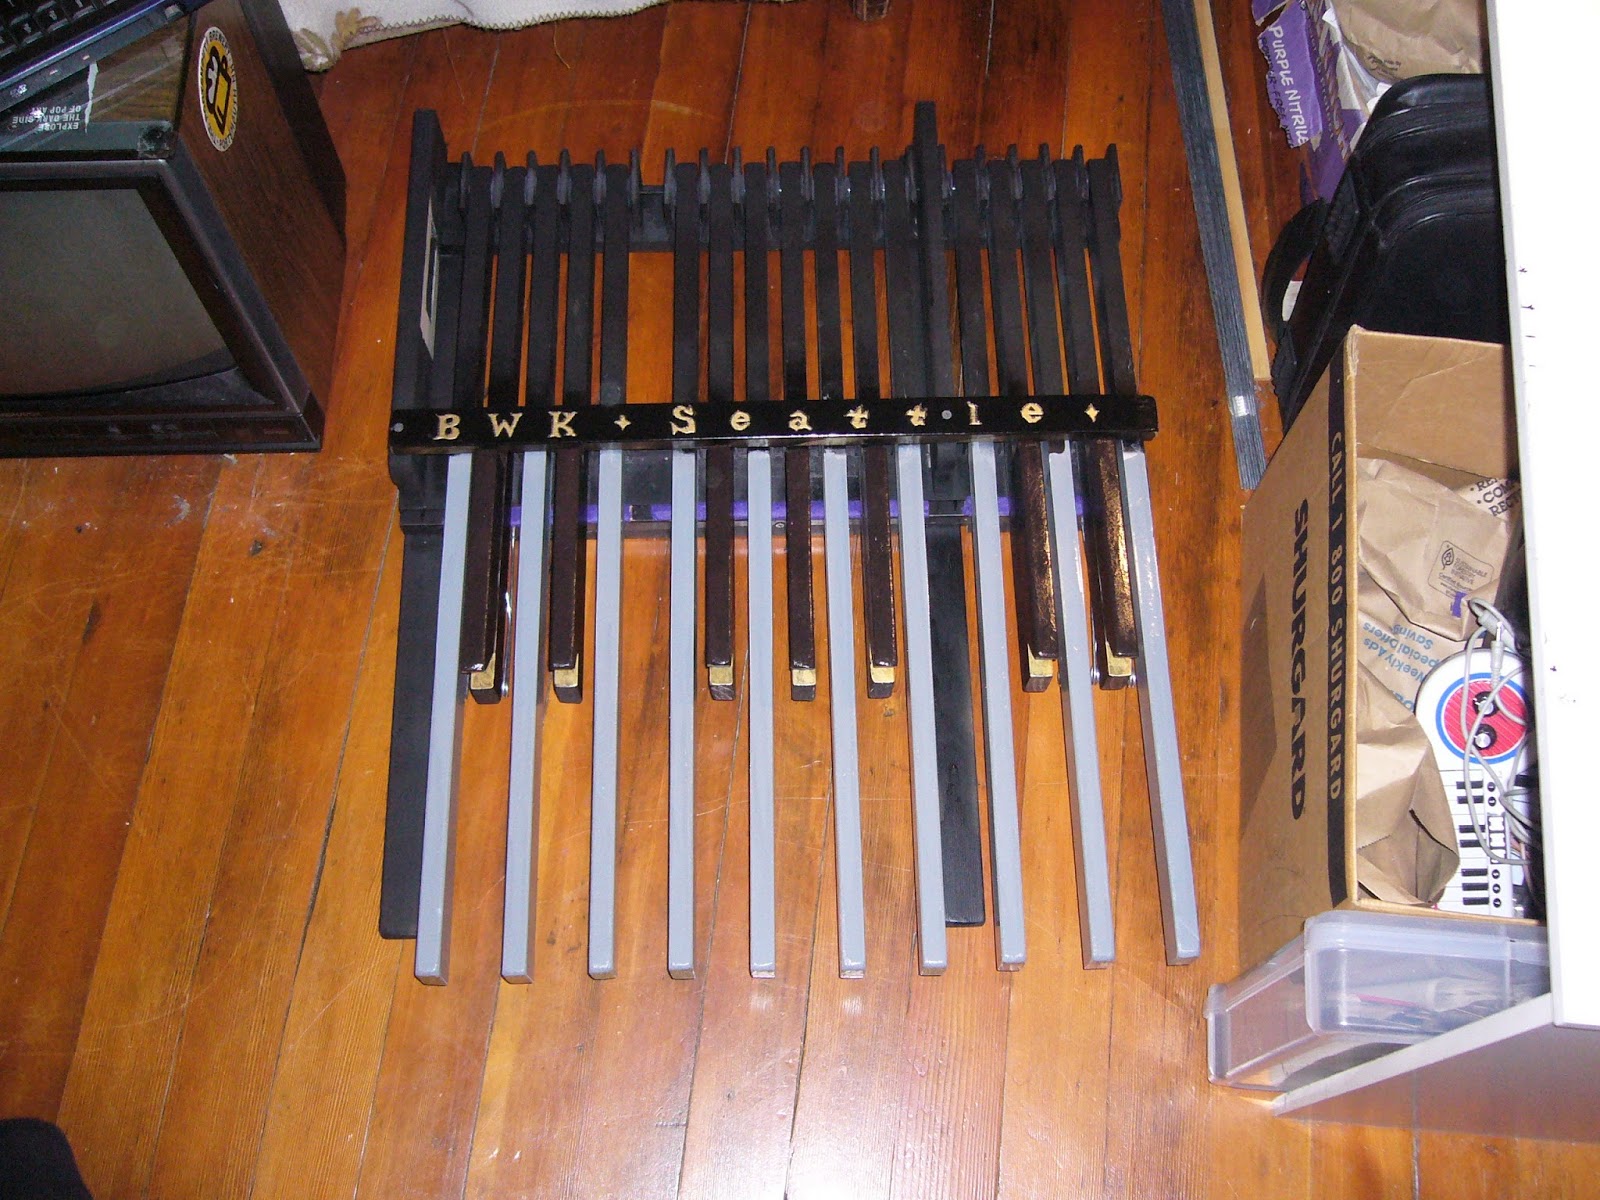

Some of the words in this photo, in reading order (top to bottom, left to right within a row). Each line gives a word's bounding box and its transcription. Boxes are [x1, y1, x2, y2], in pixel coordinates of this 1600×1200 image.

[1268, 25, 1294, 87] PURPLE
[1285, 89, 1309, 146] NITRILE
[49, 106, 67, 114] POP
[62, 113, 80, 122] THE
[69, 105, 81, 113] OF
[38, 122, 79, 131] EXPLORE
[1331, 431, 1343, 505] CALL
[1332, 513, 1343, 532] 1
[1331, 545, 1343, 606] 800
[1363, 638, 1388, 657] Ads
[1397, 643, 1440, 668] pecial
[1291, 499, 1309, 820] SHURGARD
[1330, 617, 1343, 800] SHURGARD
